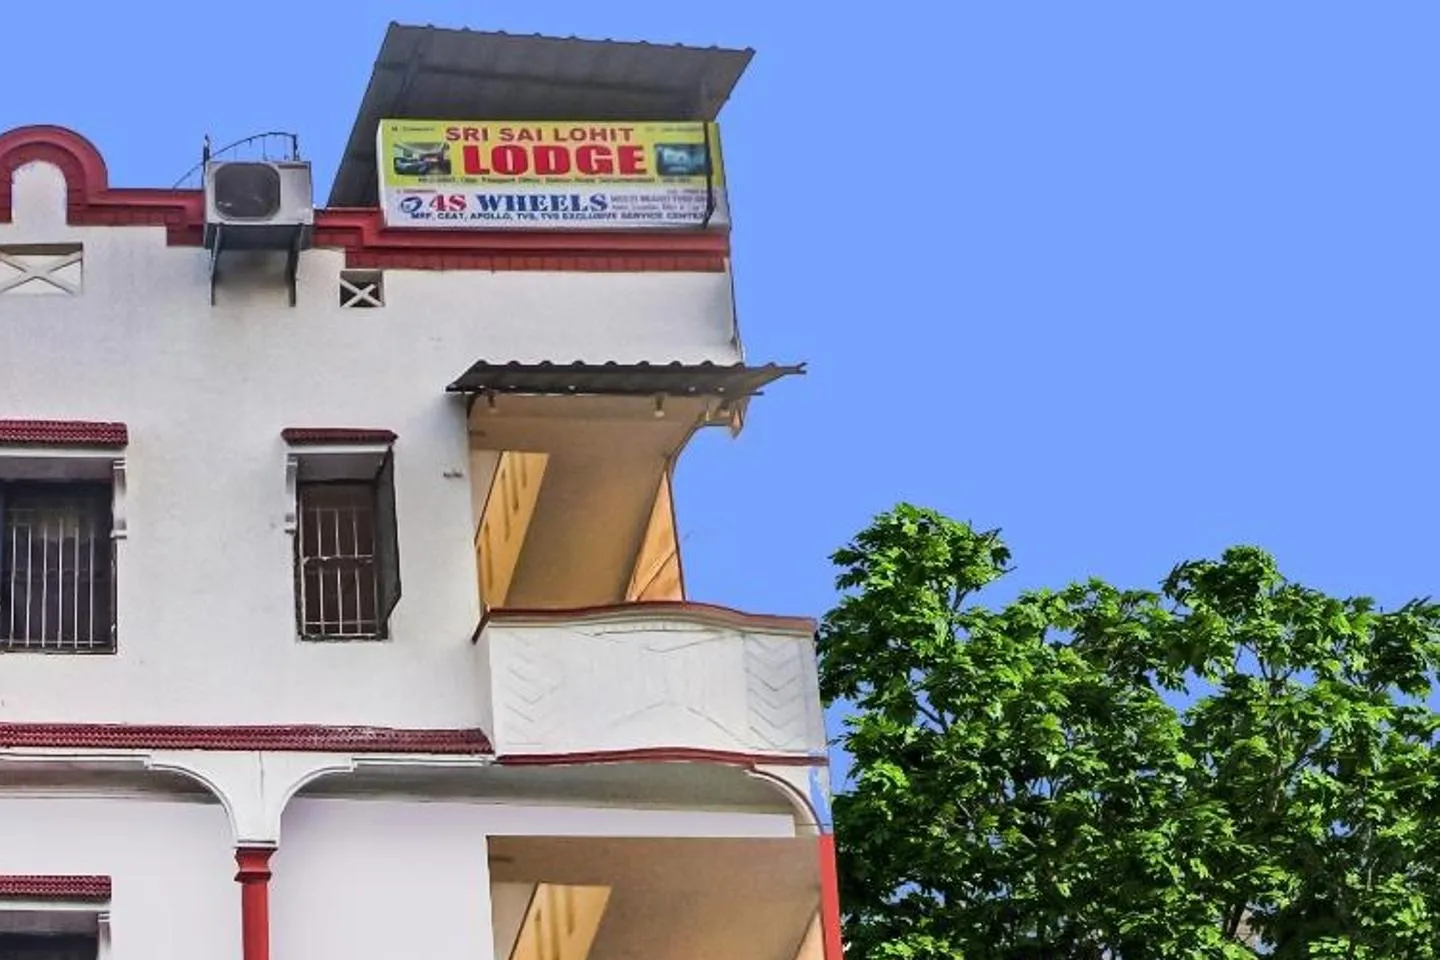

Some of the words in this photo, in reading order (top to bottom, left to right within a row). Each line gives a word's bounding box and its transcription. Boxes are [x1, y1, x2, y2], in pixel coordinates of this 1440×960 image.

[446, 127, 488, 142] SRI
[499, 127, 542, 142] SAI
[554, 127, 634, 142] LOHIT
[462, 144, 648, 176] LODGE
[429, 194, 467, 213] 4S
[476, 193, 608, 213] WHEELS
[470, 212, 513, 221] APOLLO,
